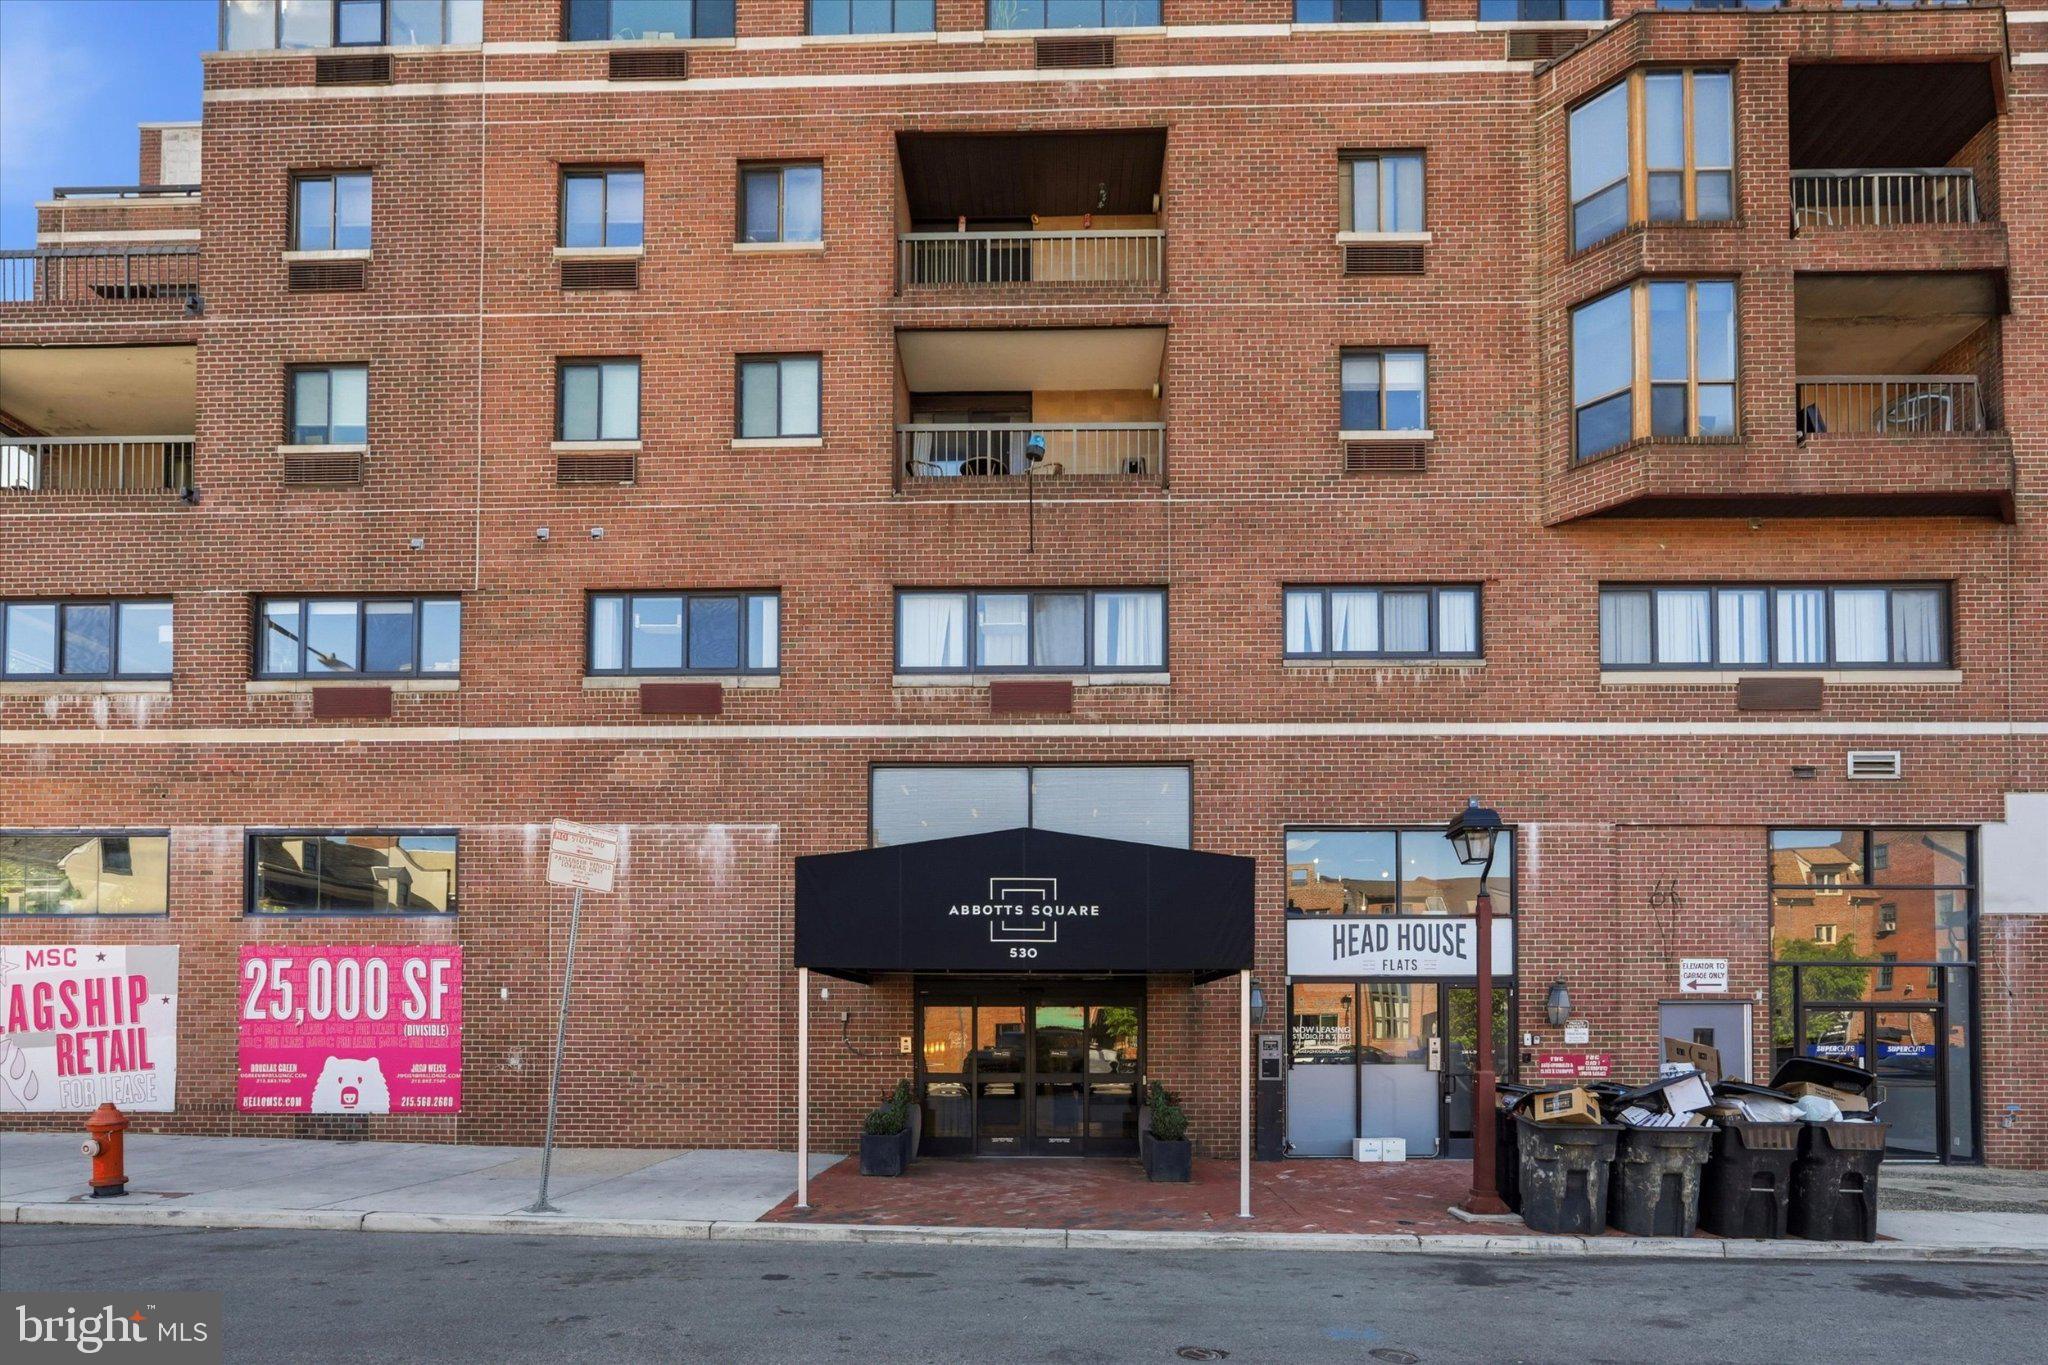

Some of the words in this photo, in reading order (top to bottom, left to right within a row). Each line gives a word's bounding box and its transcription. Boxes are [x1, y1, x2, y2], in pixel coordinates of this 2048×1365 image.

[949, 905, 1024, 915] ABBOTTS
[1031, 905, 1100, 917] SQUARE
[1333, 924, 1389, 961] HEAD
[1397, 923, 1467, 960] HOUSE
[26, 947, 77, 971] MSC
[1009, 948, 1038, 958] 530
[1382, 959, 1418, 971] FLATS
[1683, 962, 1714, 970] ELEVATOR
[1716, 962, 1725, 970] TO
[244, 957, 388, 1028] 25,000
[402, 957, 451, 1020] SF
[0, 974, 149, 1035] AGSHIP
[403, 1023, 449, 1036] (DIVISIBLE)
[56, 1027, 155, 1077] RETAIL
[251, 1063, 277, 1073] DOUGLAS
[59, 1079, 96, 1108] FOR
[101, 1074, 157, 1104] LEASE
[243, 1096, 302, 1107] HELLOMSC.COM
